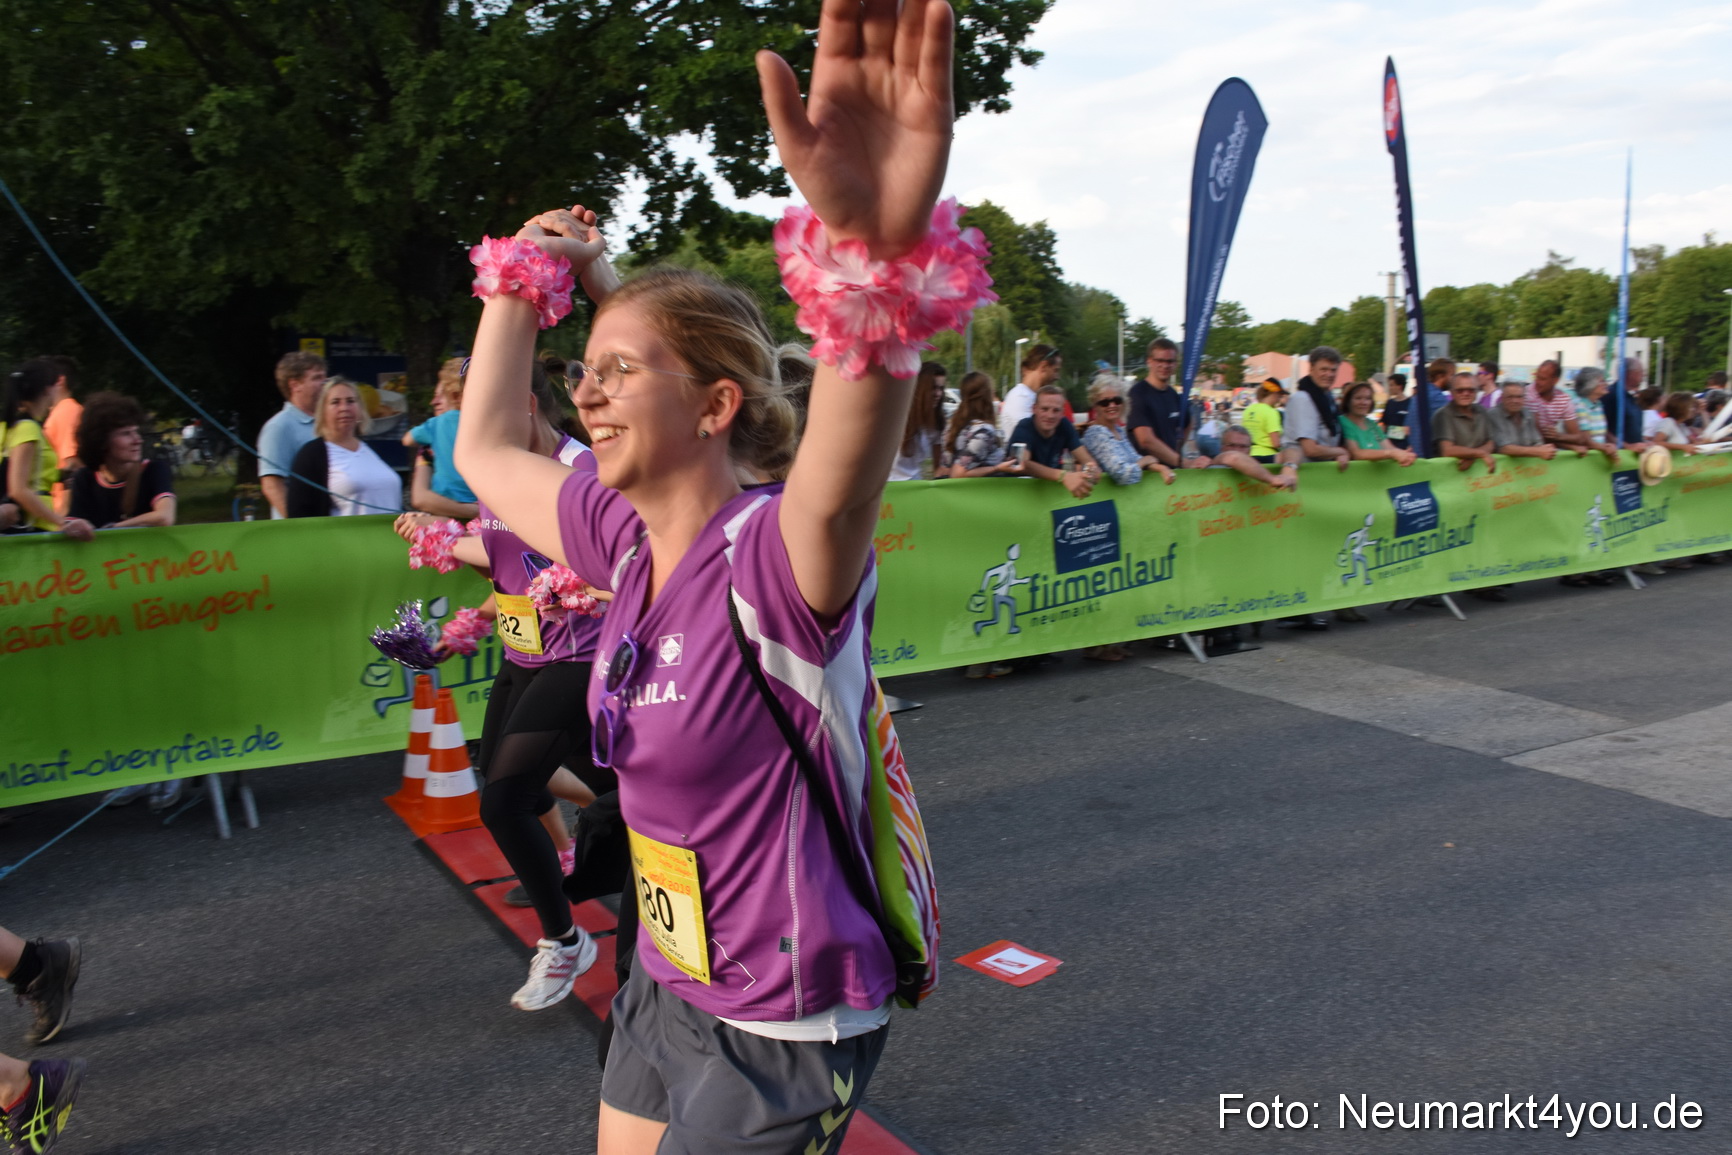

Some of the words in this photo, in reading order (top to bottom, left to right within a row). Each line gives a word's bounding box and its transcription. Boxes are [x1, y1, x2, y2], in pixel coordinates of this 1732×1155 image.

[873, 521, 916, 566] ger!
[1065, 522, 1112, 540] Fischer
[103, 549, 238, 590] Firmen
[1029, 542, 1177, 611] firmenlauf
[132, 575, 275, 632] länger!
[497, 612, 522, 636] 82
[1030, 600, 1101, 626] neumarkt
